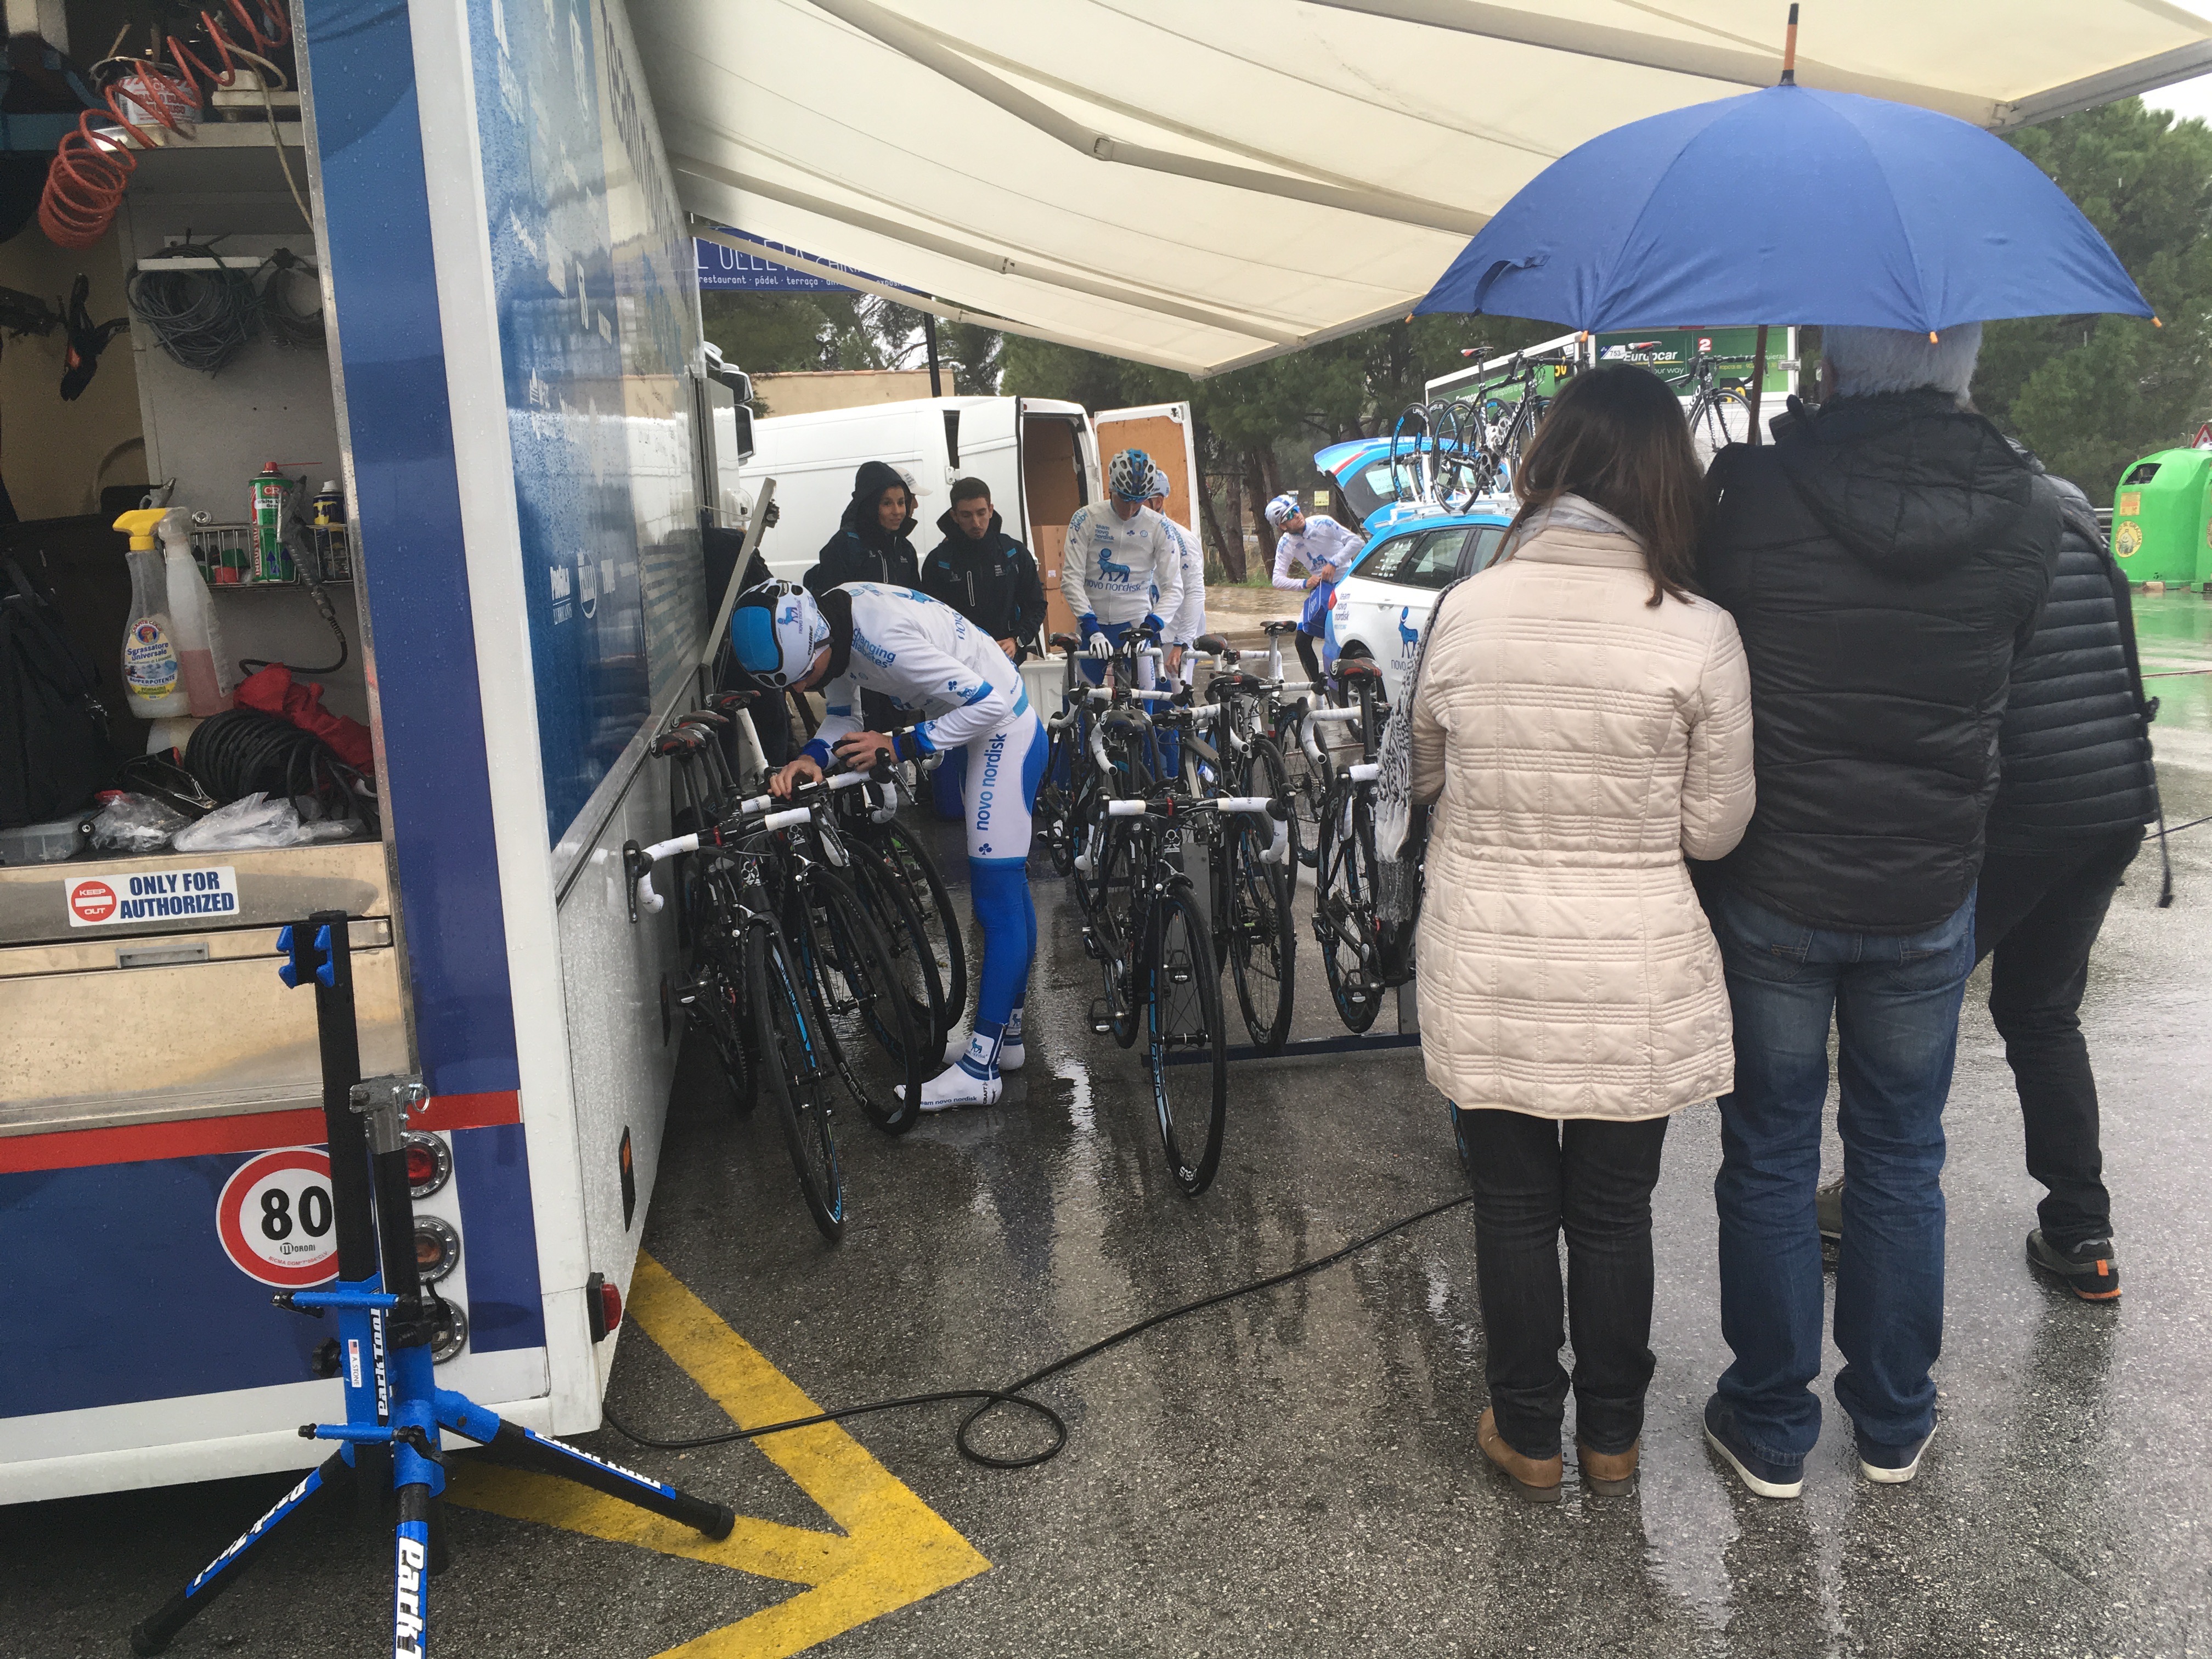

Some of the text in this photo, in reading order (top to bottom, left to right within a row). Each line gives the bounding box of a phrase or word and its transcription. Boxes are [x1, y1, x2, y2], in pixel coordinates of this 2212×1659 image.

[699, 275, 747, 284] restaurant
[755, 275, 778, 286] pádel
[786, 276, 819, 288] terraça
[1699, 338, 1711, 351] 2
[1085, 578, 1141, 592] novo nordisk
[1334, 611, 1350, 621] nordisk
[127, 642, 169, 656] Sgrassatore
[853, 628, 896, 663] changing
[131, 649, 167, 661] universale
[1391, 659, 1407, 671] novo
[129, 674, 175, 684] SUPERPOTENTE
[977, 733, 1007, 831] novo nordisk
[129, 871, 220, 896] ONLY FOR
[120, 892, 235, 919] AUTHORIZED
[261, 1186, 332, 1241] 80
[352, 1364, 360, 1386] STONE
